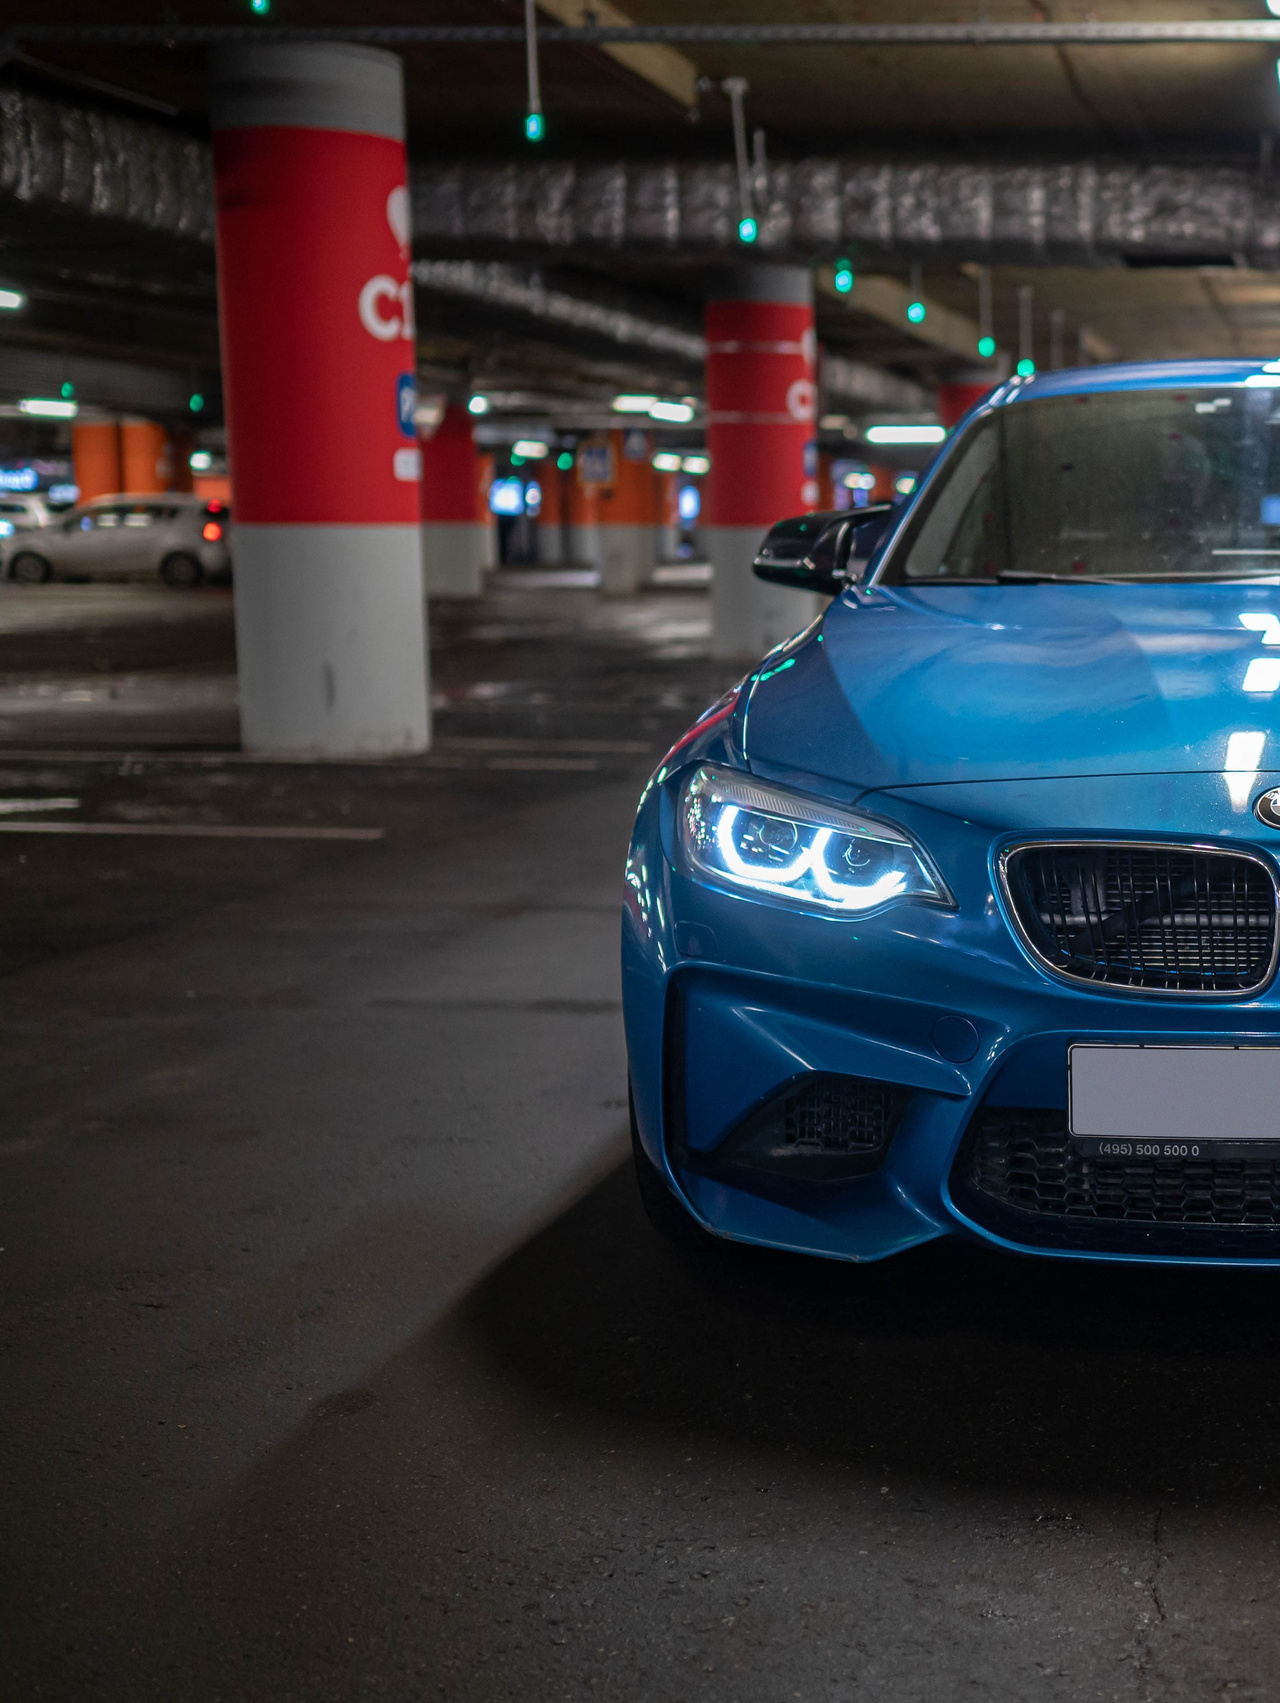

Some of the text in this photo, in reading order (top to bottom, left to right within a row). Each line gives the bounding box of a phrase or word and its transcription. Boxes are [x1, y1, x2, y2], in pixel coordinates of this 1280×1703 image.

[1100, 1142, 1200, 1156] (495) 500 500 0
